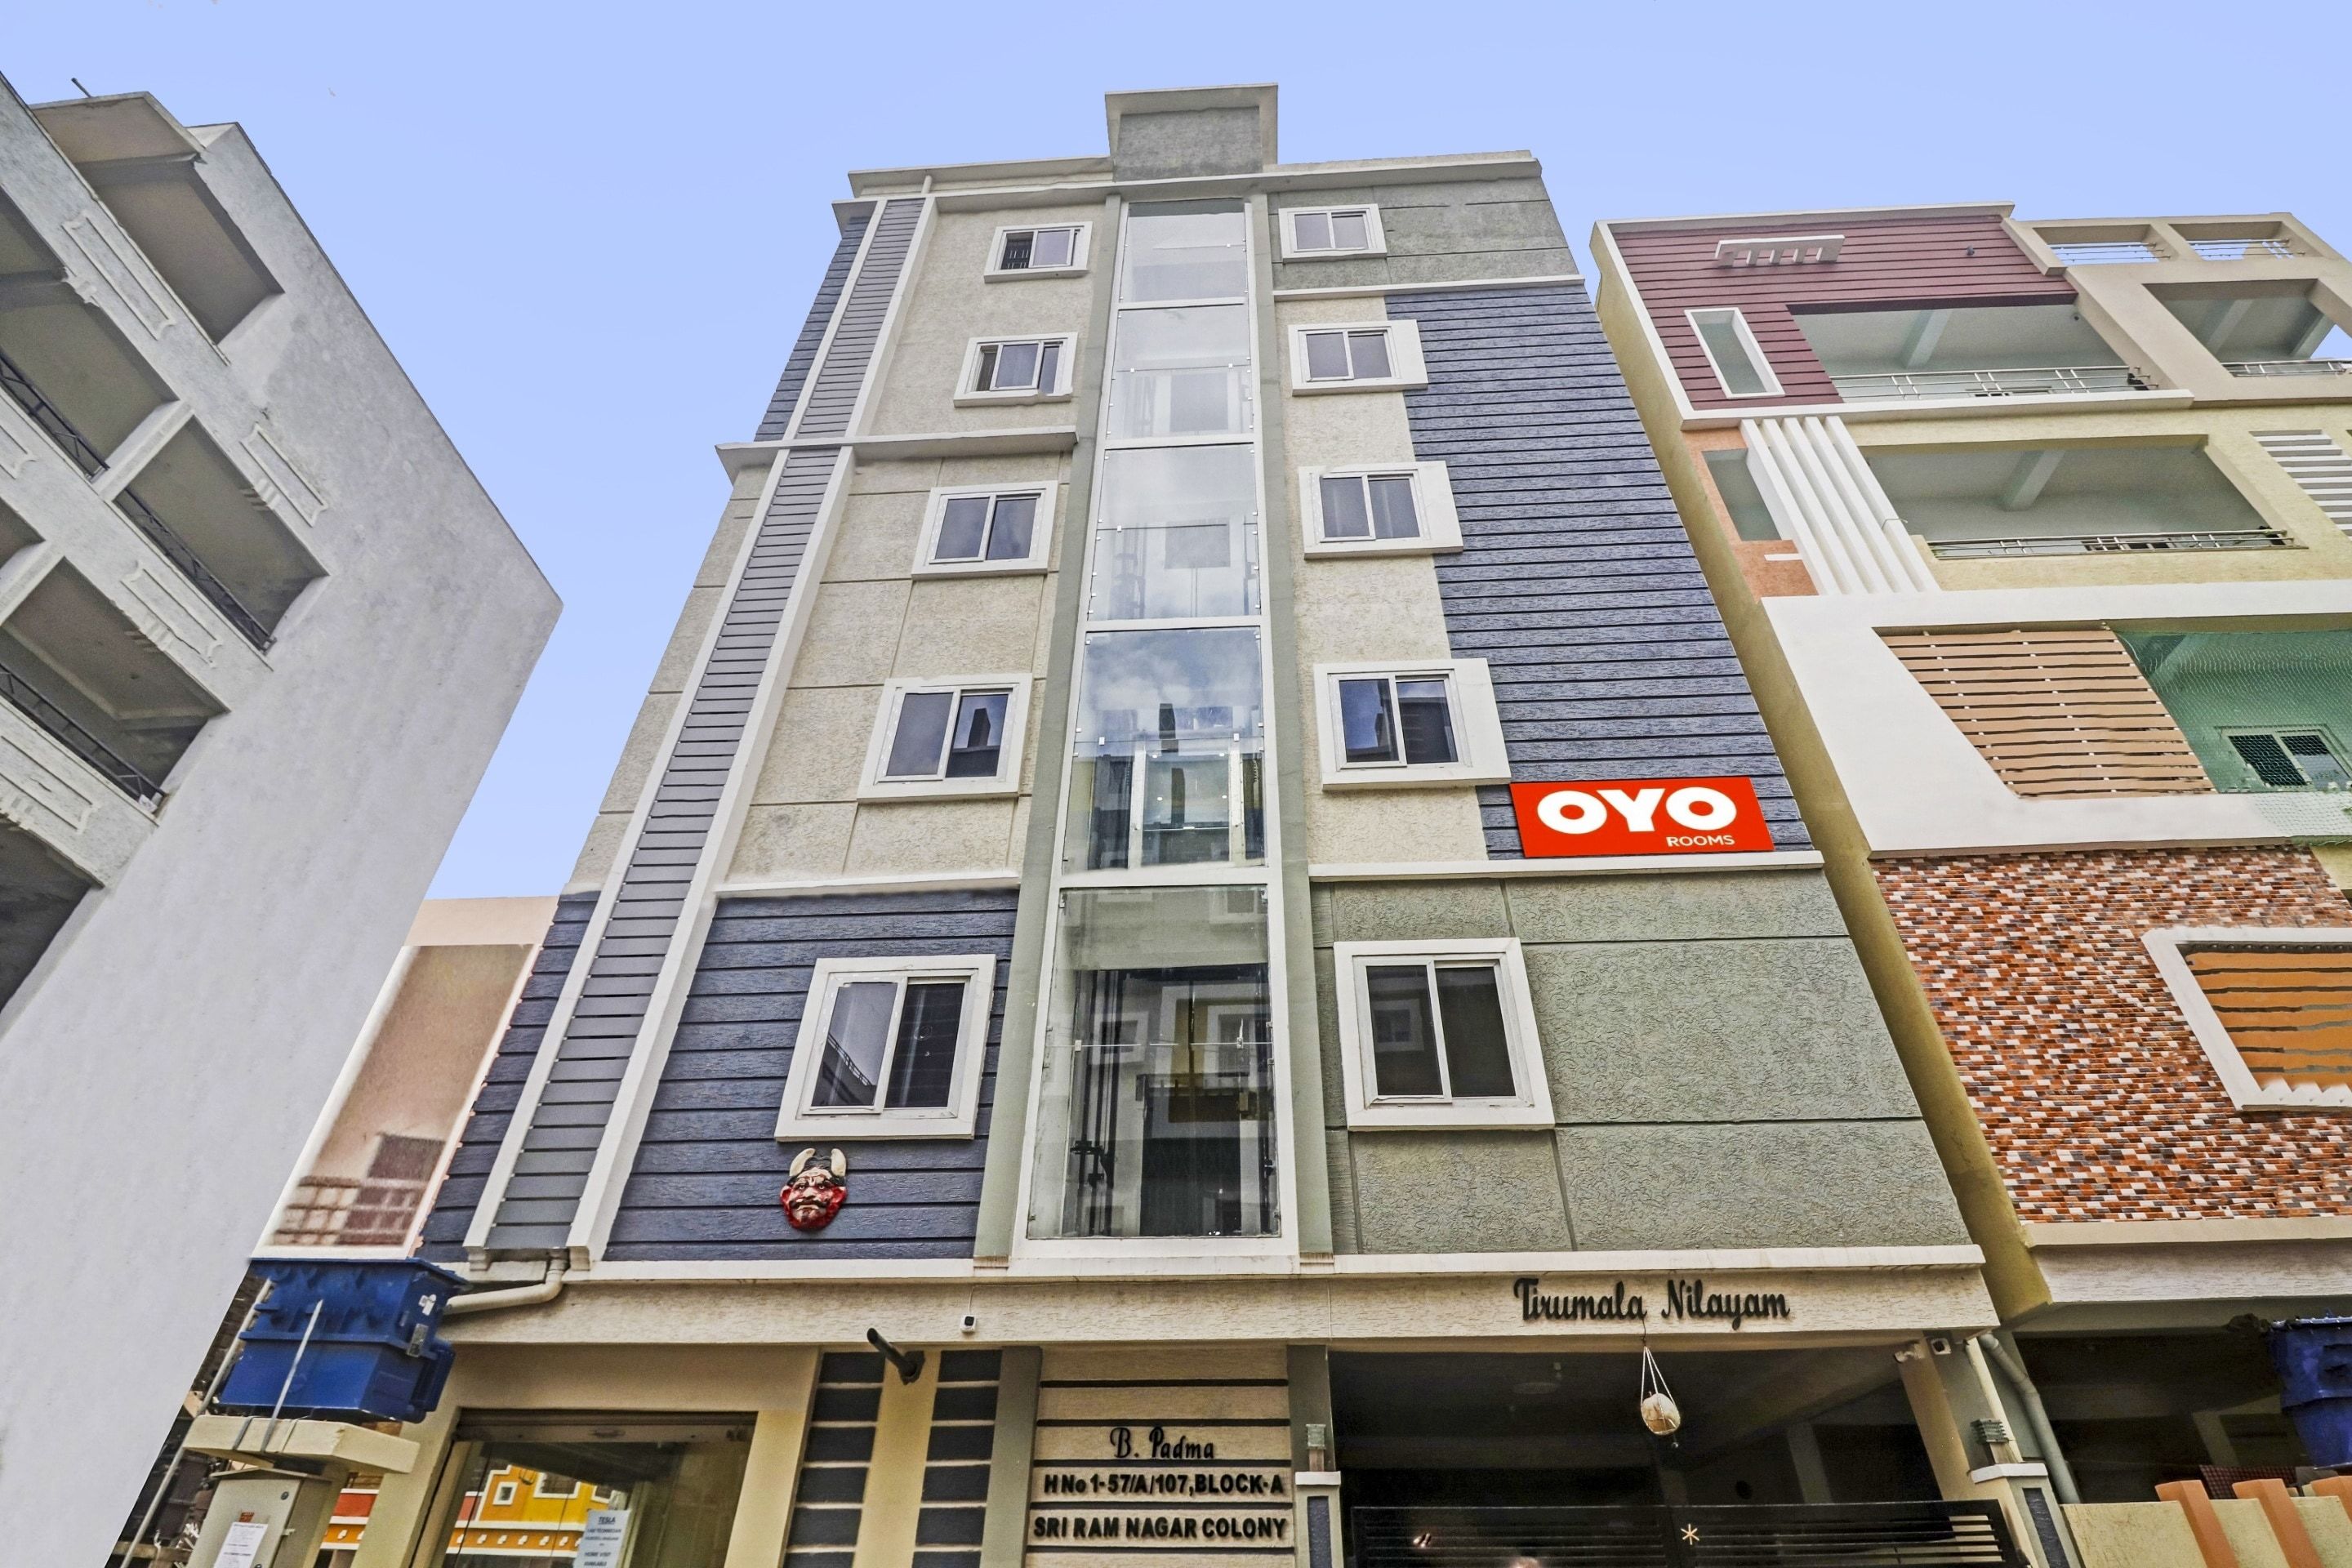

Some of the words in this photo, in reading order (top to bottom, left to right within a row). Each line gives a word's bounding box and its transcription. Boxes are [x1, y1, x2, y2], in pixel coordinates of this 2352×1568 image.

[1536, 786, 1737, 835] OYO
[1666, 835, 1735, 847] ROOMS
[1513, 1277, 1647, 1321] Tirumala
[1661, 1279, 1790, 1330] Nilayam
[1110, 1427, 1139, 1459] B.
[1149, 1426, 1214, 1459] Padma
[1034, 1517, 1067, 1537] SRI
[1073, 1517, 1120, 1537] RAM
[1126, 1517, 1197, 1538] NAGAR
[1202, 1517, 1287, 1539] COLONY
